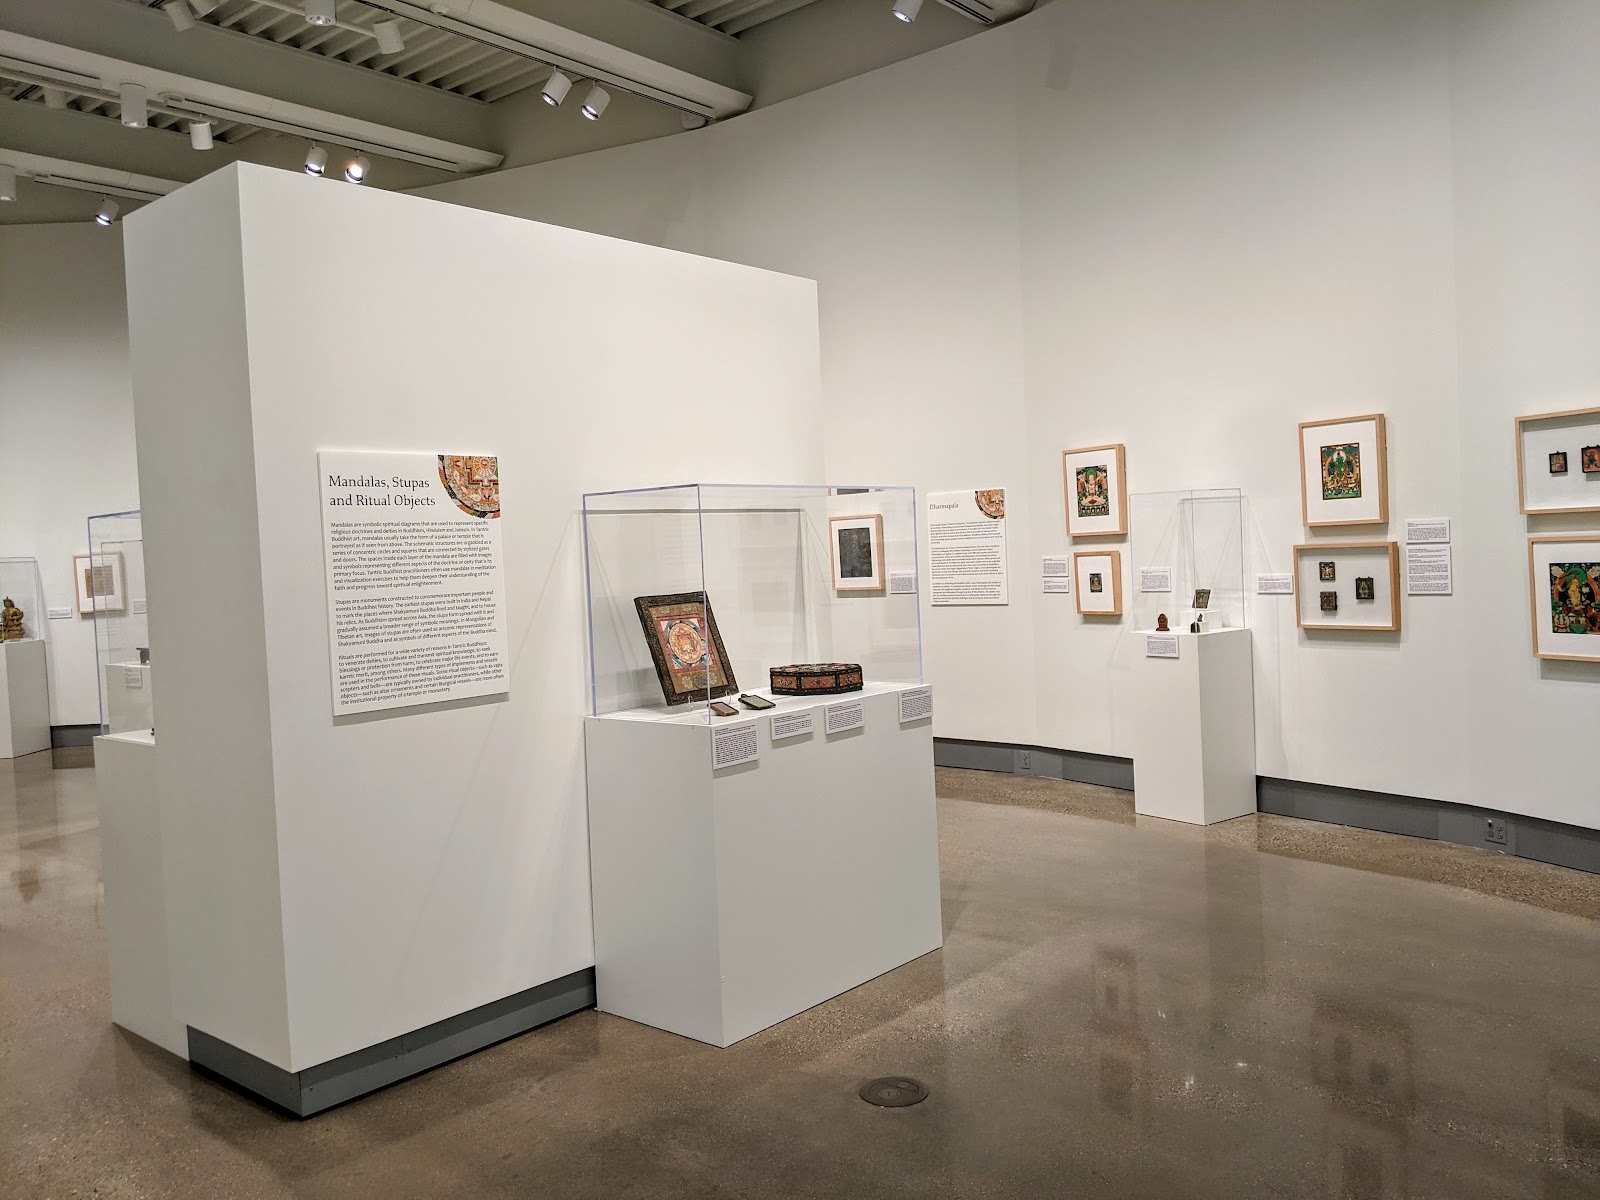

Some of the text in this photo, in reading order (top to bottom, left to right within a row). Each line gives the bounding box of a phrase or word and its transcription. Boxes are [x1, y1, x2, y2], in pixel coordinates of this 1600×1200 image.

[328, 474, 430, 491] Mandalas, Stupas
[329, 493, 436, 509] and Ritual Objects
[331, 542, 356, 550] portrayed
[333, 570, 352, 578] primary
[403, 567, 430, 575] practitioners
[342, 563, 362, 571] symbols
[362, 562, 392, 570] representing
[344, 576, 372, 584] visualization
[448, 571, 478, 579] understanding
[335, 598, 352, 606] Stupas
[387, 594, 414, 602] constructed
[363, 610, 378, 618] places
[393, 608, 420, 616] Shakyamuni
[387, 615, 403, 623] spread
[336, 626, 359, 634] gradually
[420, 619, 439, 627] symbolic
[364, 631, 381, 639] images
[386, 629, 402, 637] stupas
[455, 622, 488, 631] representations
[337, 639, 366, 648] Shakyamuni
[398, 634, 417, 642] symbols
[363, 650, 388, 659] performed
[410, 646, 425, 654] variety
[388, 654, 408, 662] cultivate
[435, 650, 453, 658] spiritual
[338, 666, 361, 674] blessings
[366, 662, 391, 671] protection
[339, 672, 355, 680] karmic
[373, 674, 403, 683] performance
[393, 679, 412, 687] typically
[377, 693, 398, 702] property
[406, 689, 422, 698] temple
